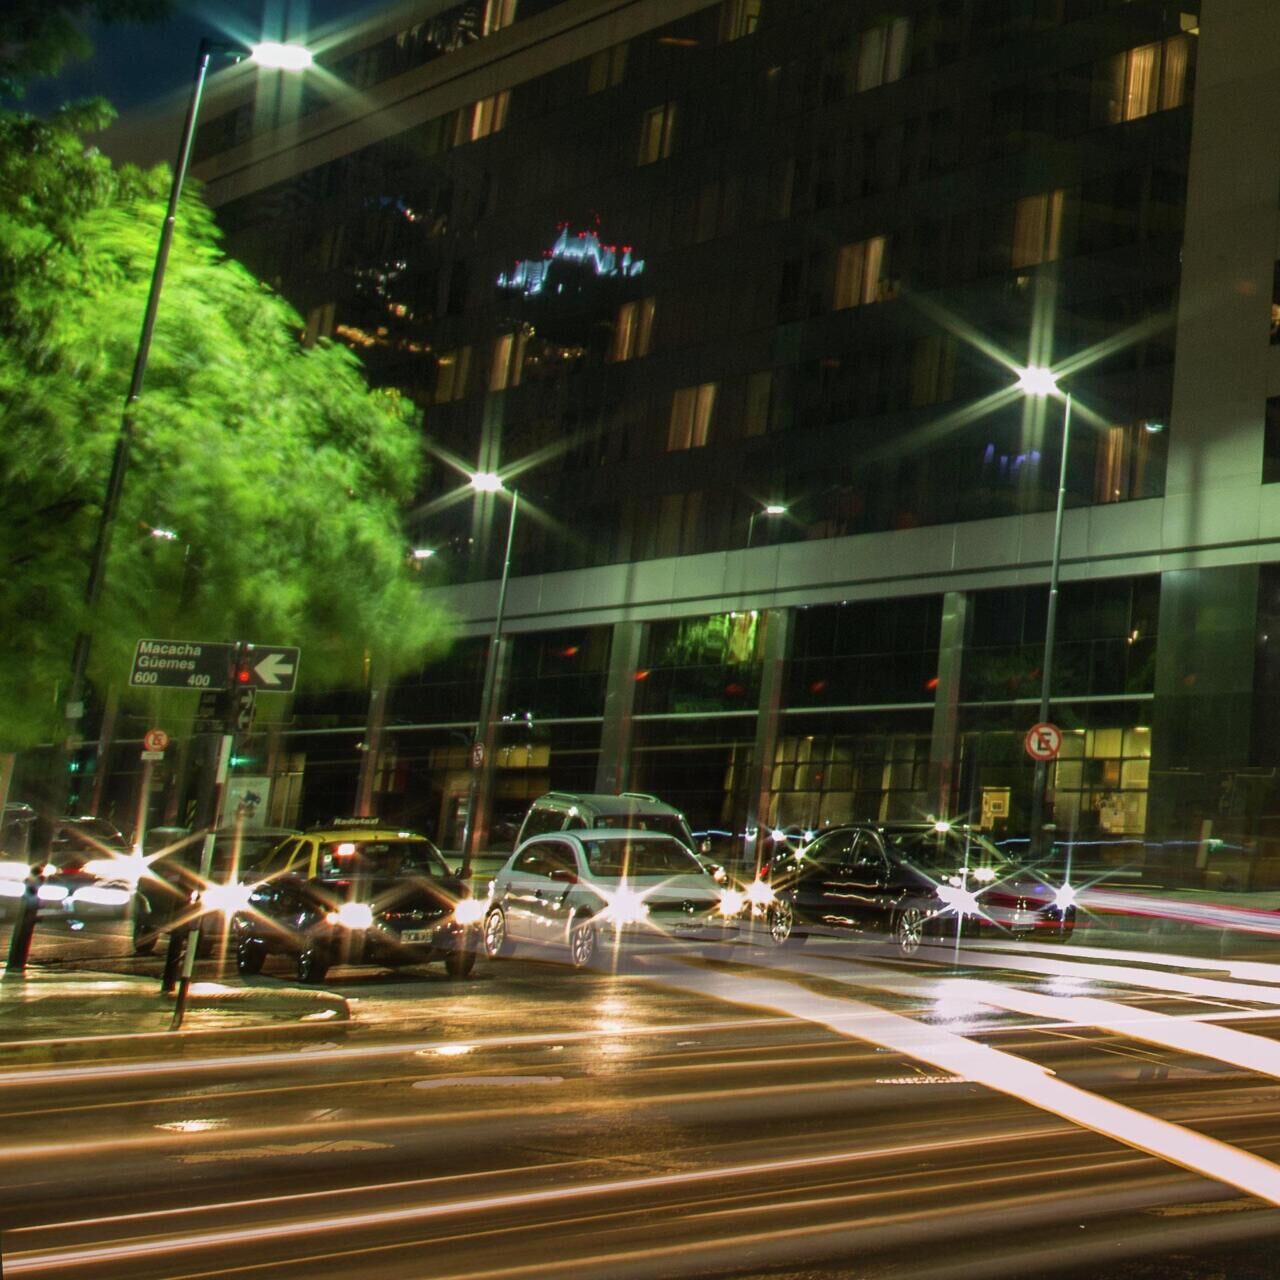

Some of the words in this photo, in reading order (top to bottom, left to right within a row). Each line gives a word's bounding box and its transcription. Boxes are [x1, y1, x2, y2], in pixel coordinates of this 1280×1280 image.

[139, 641, 202, 656] Macacha
[137, 655, 196, 670] Güemes
[134, 671, 158, 684] 600
[187, 674, 211, 687] 400
